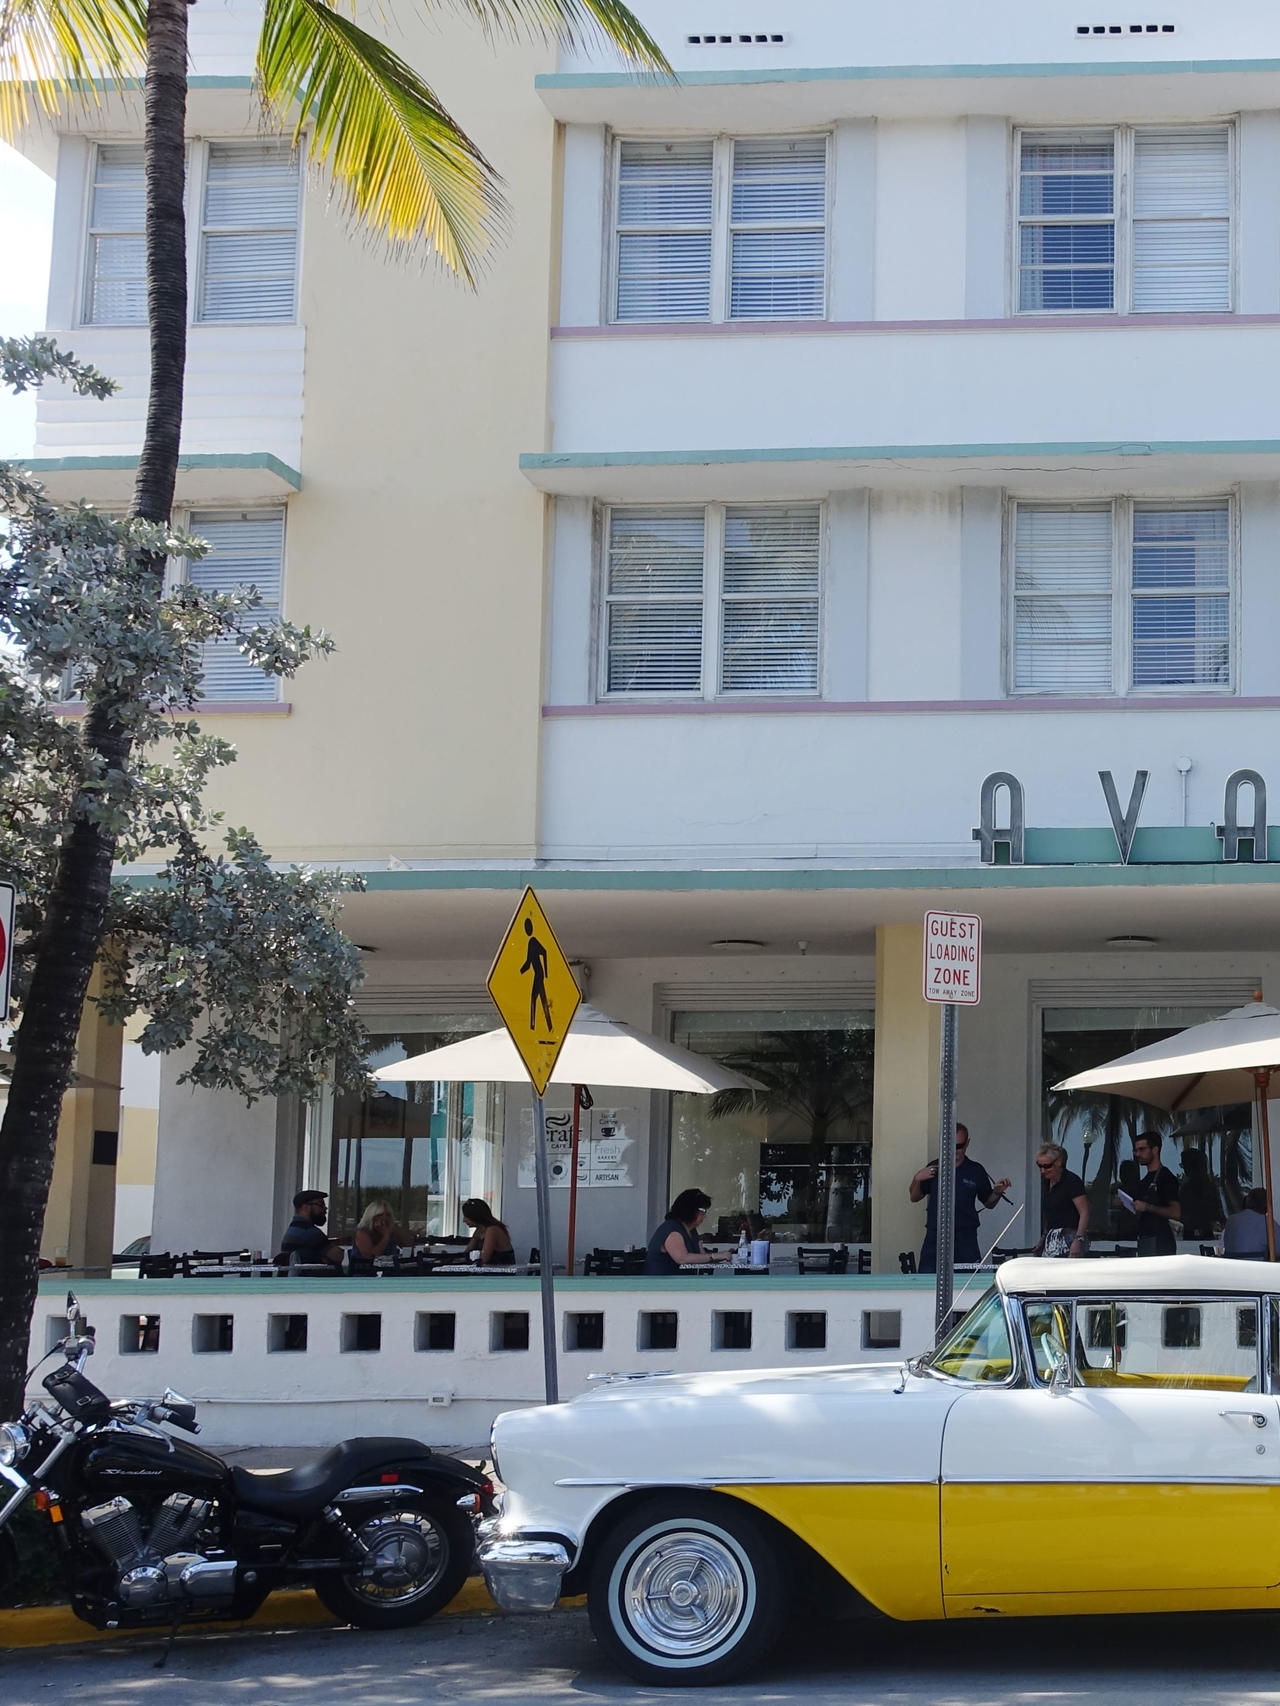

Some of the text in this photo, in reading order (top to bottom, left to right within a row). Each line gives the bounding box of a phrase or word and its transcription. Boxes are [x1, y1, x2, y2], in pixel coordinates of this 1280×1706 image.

[931, 919, 975, 939] GUEST
[930, 943, 975, 962] LOADING
[933, 967, 970, 986] ZONE
[928, 987, 975, 998] TOW AWAY ZONE
